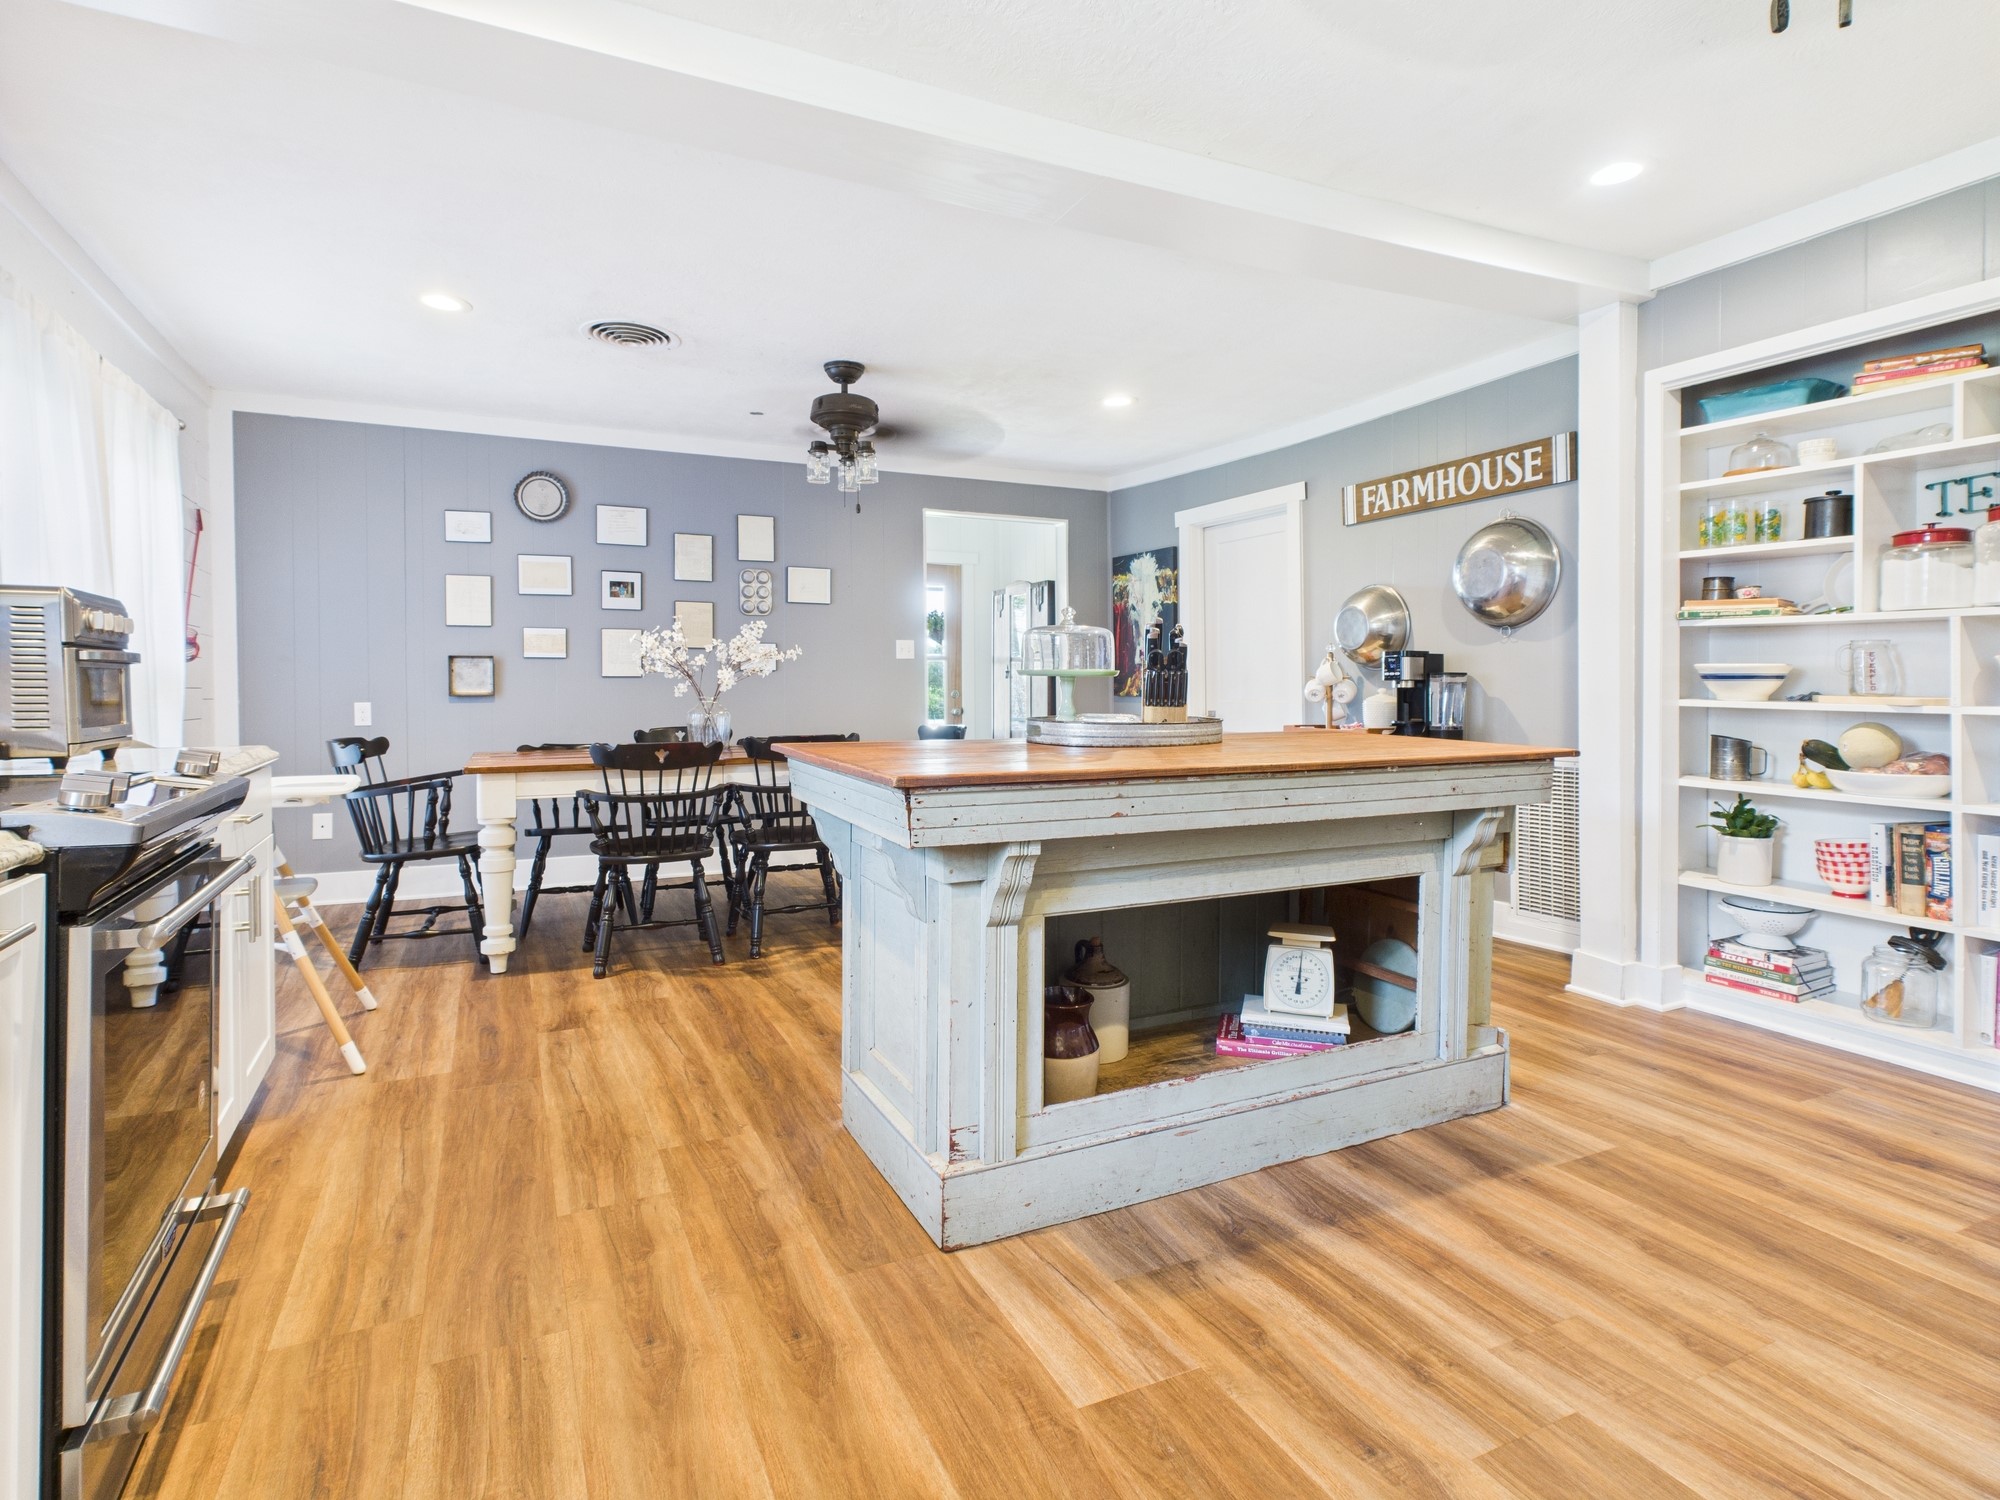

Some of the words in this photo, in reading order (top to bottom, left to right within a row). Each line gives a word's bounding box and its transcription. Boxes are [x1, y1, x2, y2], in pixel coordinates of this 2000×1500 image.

[1362, 446, 1543, 516] FARMHOUSE
[1933, 856, 1950, 897] GRILLING
[1720, 952, 1748, 964] TEXAS
[1752, 959, 1775, 970] EATS
